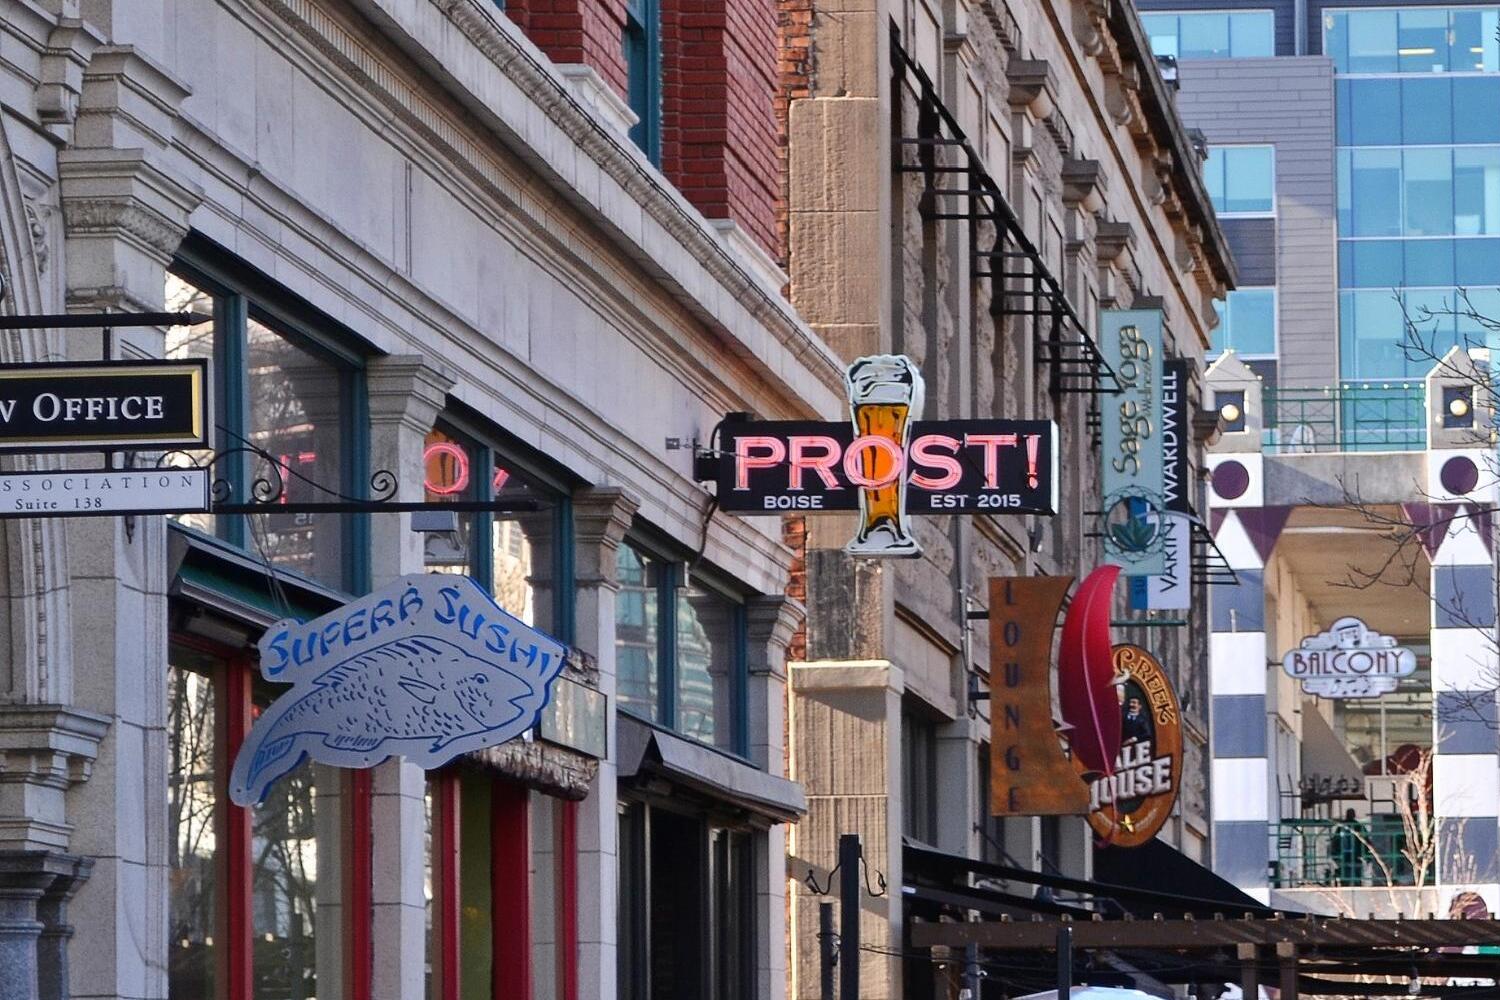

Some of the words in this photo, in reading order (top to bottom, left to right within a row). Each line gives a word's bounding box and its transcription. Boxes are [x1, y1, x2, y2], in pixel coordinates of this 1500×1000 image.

[733, 433, 1042, 492] PROST!
[1112, 400, 1149, 477] Sage
[1162, 370, 1178, 501] WARDWELL
[0, 474, 193, 493] SSOCIATION
[15, 499, 58, 510] Suite
[74, 497, 103, 509] 138
[763, 496, 824, 510] BOISE
[930, 495, 969, 509] EST
[977, 494, 1022, 508] 2015
[266, 587, 424, 676] SUPERB
[433, 587, 551, 677] SUSHI
[1112, 647, 1177, 726] CREEK
[1293, 651, 1404, 675] BALCONY
[1004, 580, 1021, 812] LOUNGE
